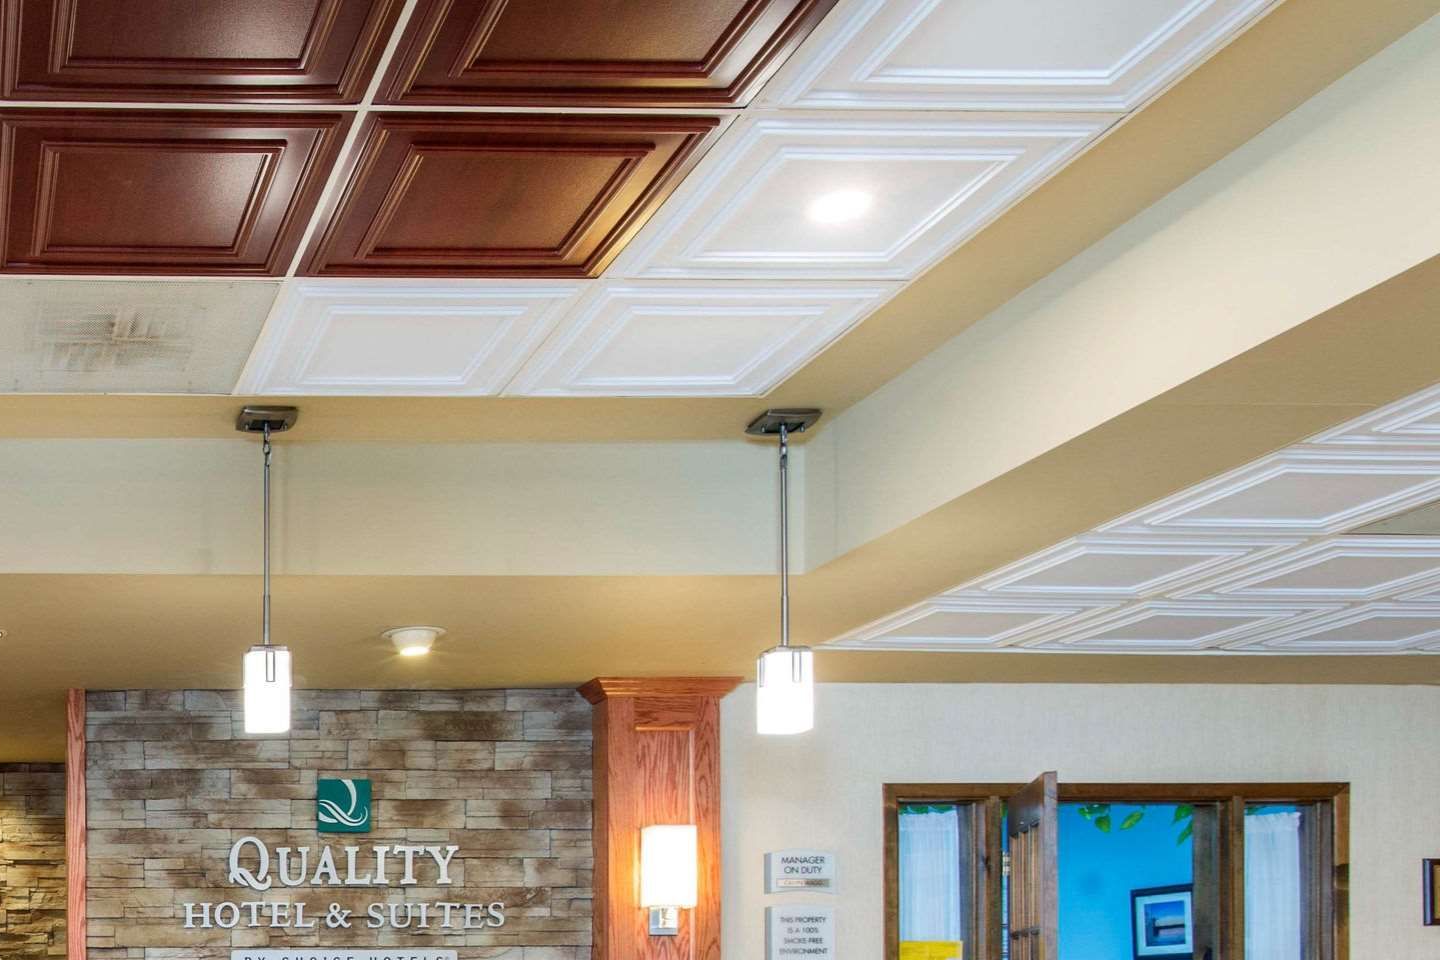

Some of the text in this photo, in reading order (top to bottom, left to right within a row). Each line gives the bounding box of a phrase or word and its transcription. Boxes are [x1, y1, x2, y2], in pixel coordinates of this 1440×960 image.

[228, 836, 459, 891] QUALITY
[781, 856, 825, 864] MANAGER
[783, 866, 823, 874] ON DUTY
[183, 902, 506, 929] HOTEL & SUITES
